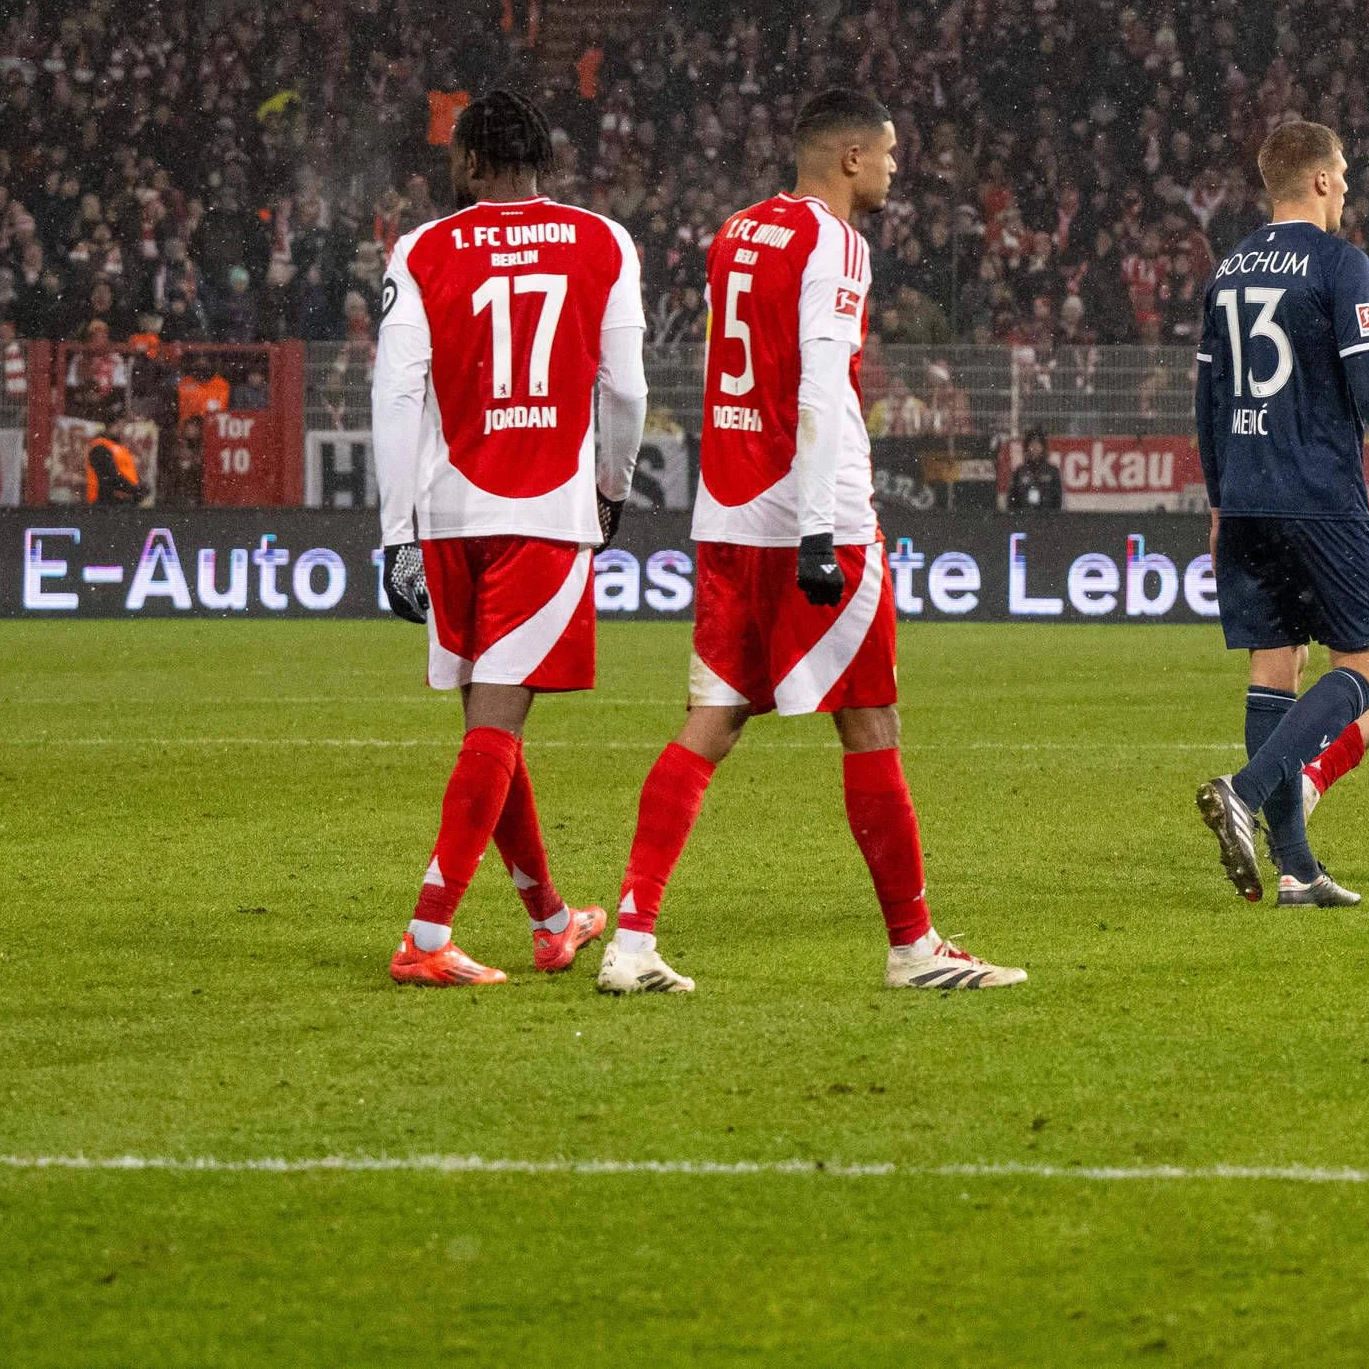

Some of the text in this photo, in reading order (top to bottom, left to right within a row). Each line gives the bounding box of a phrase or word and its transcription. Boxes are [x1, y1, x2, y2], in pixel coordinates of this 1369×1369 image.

[451, 223, 577, 250] 1. FC UNION
[490, 250, 539, 267] BERLIN
[1215, 251, 1310, 280] BOCHUM
[471, 273, 568, 399] 17
[719, 271, 756, 397] 5
[1215, 287, 1294, 398] 13
[216, 413, 255, 440] Tor
[483, 406, 557, 435] JORDAN
[220, 447, 251, 475] 10
[23, 527, 347, 611] E-Auto
